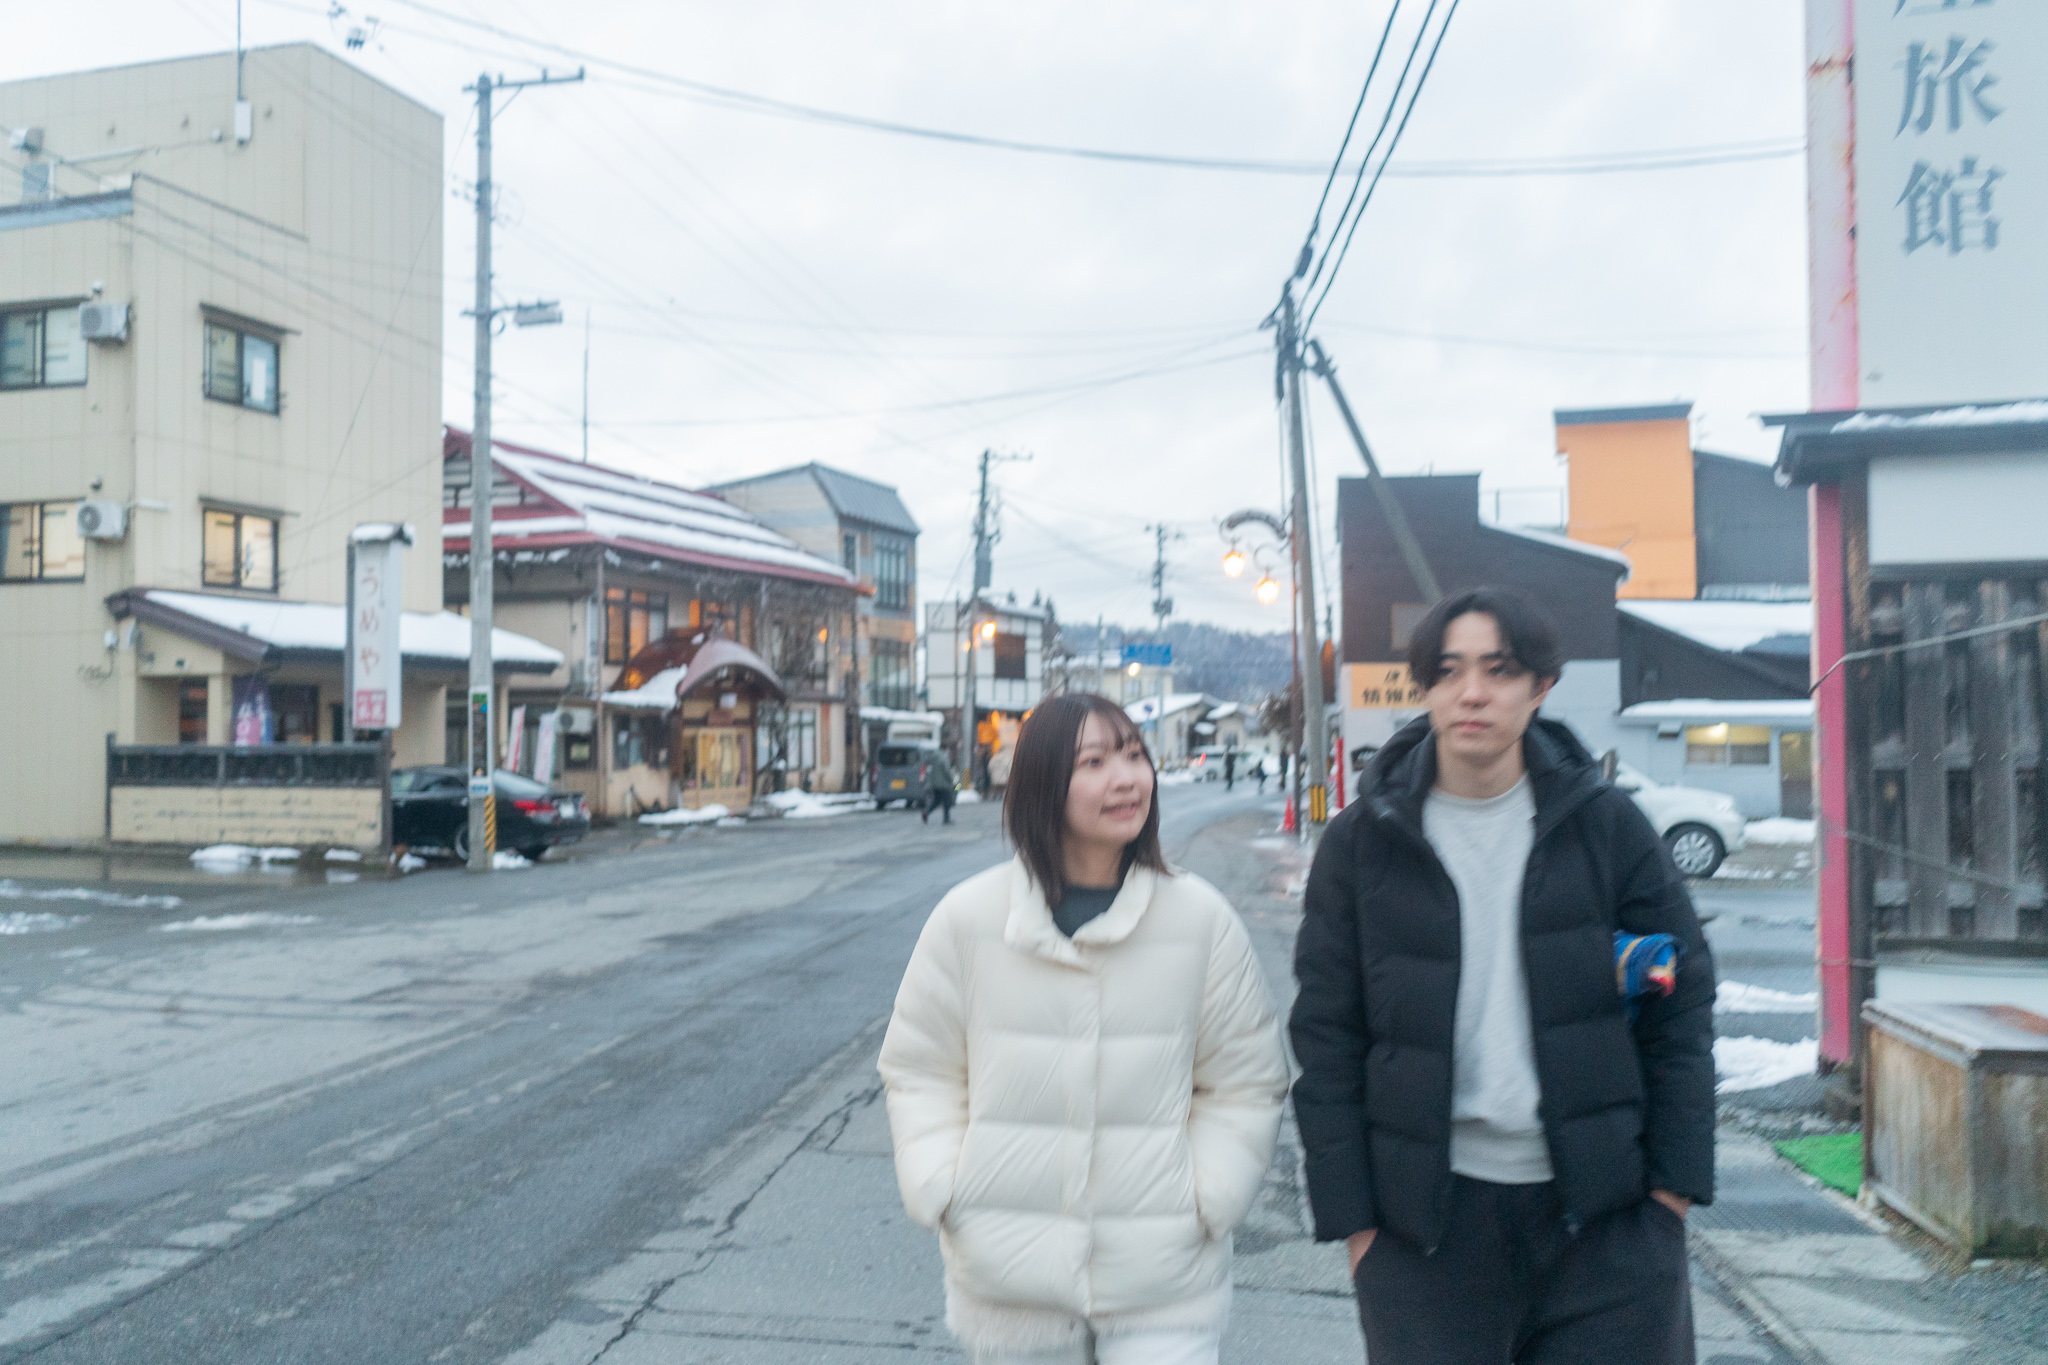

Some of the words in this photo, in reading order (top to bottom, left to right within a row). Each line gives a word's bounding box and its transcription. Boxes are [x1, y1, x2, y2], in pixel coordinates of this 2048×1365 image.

[1891, 0, 2007, 257] 旅館
[360, 566, 379, 676] うめや
